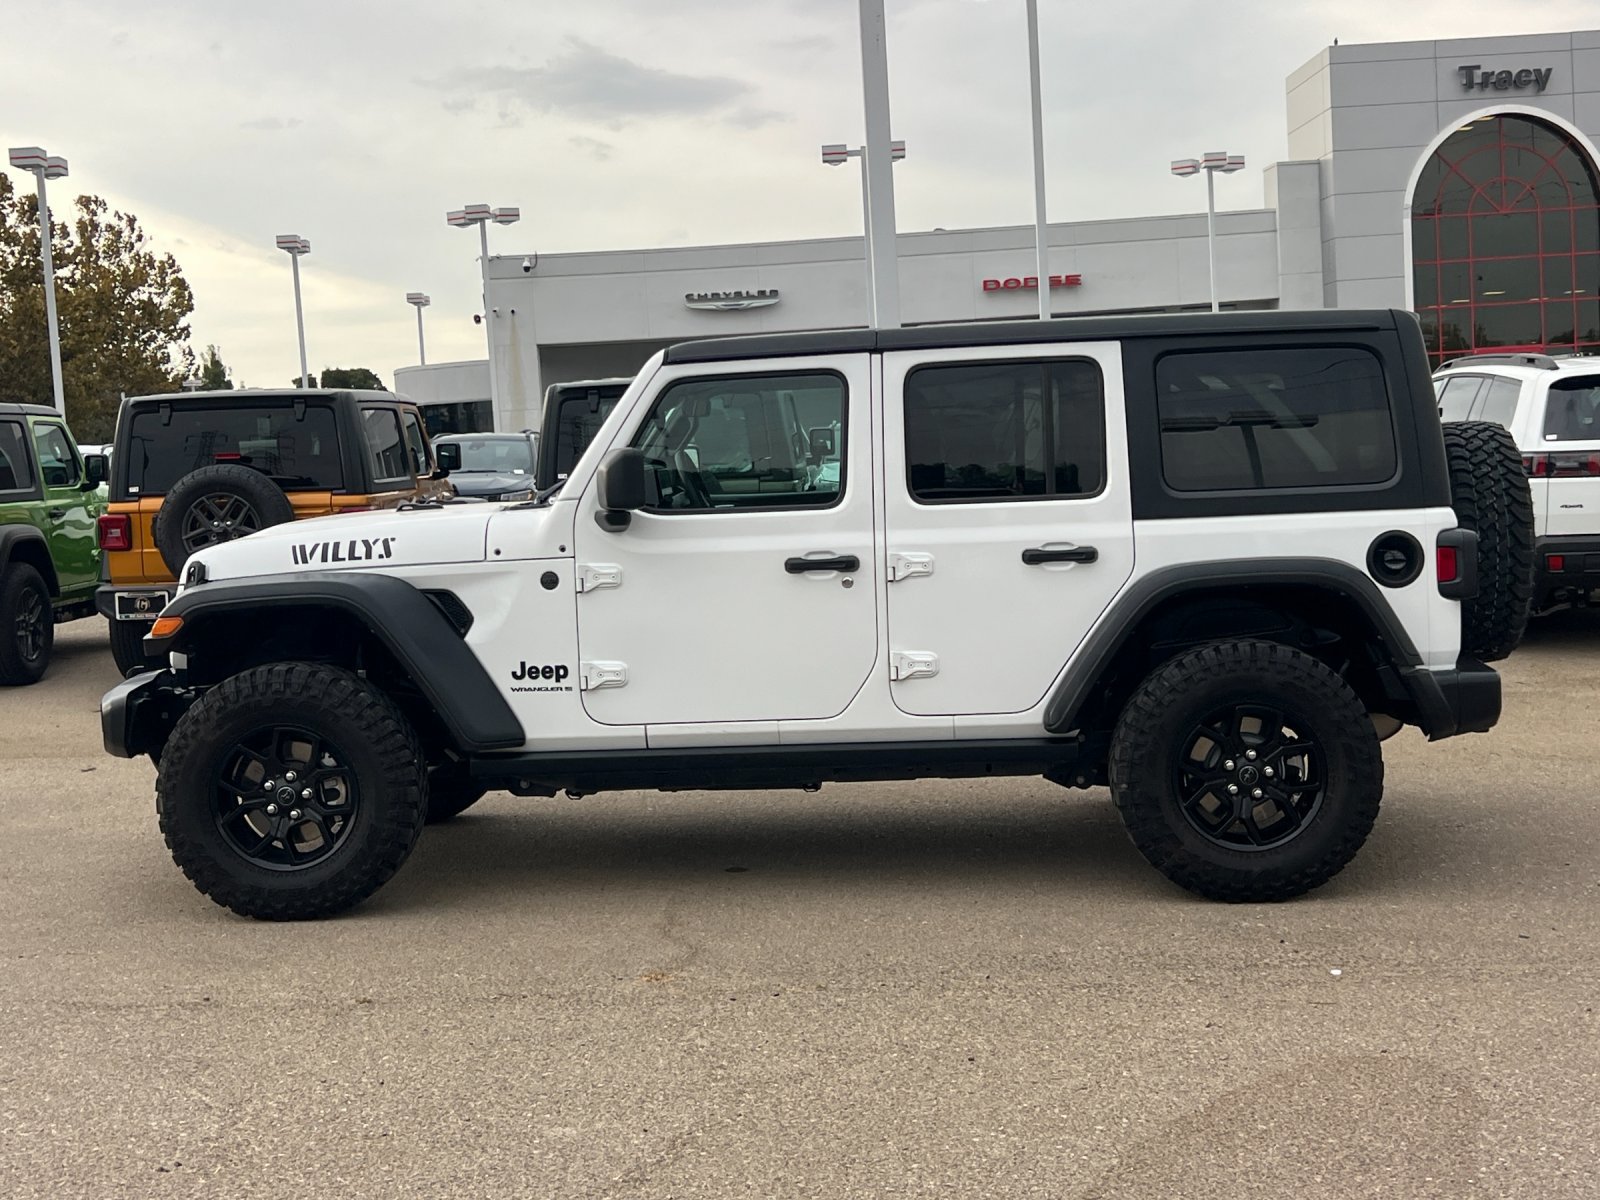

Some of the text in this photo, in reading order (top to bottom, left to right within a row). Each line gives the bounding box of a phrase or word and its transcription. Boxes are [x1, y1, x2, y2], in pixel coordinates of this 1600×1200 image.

[1458, 65, 1553, 92] Tracy
[983, 274, 1082, 291] DODGE
[685, 289, 779, 301] CHRYSLER
[292, 538, 396, 565] WILLYS
[511, 661, 569, 683] Jeep
